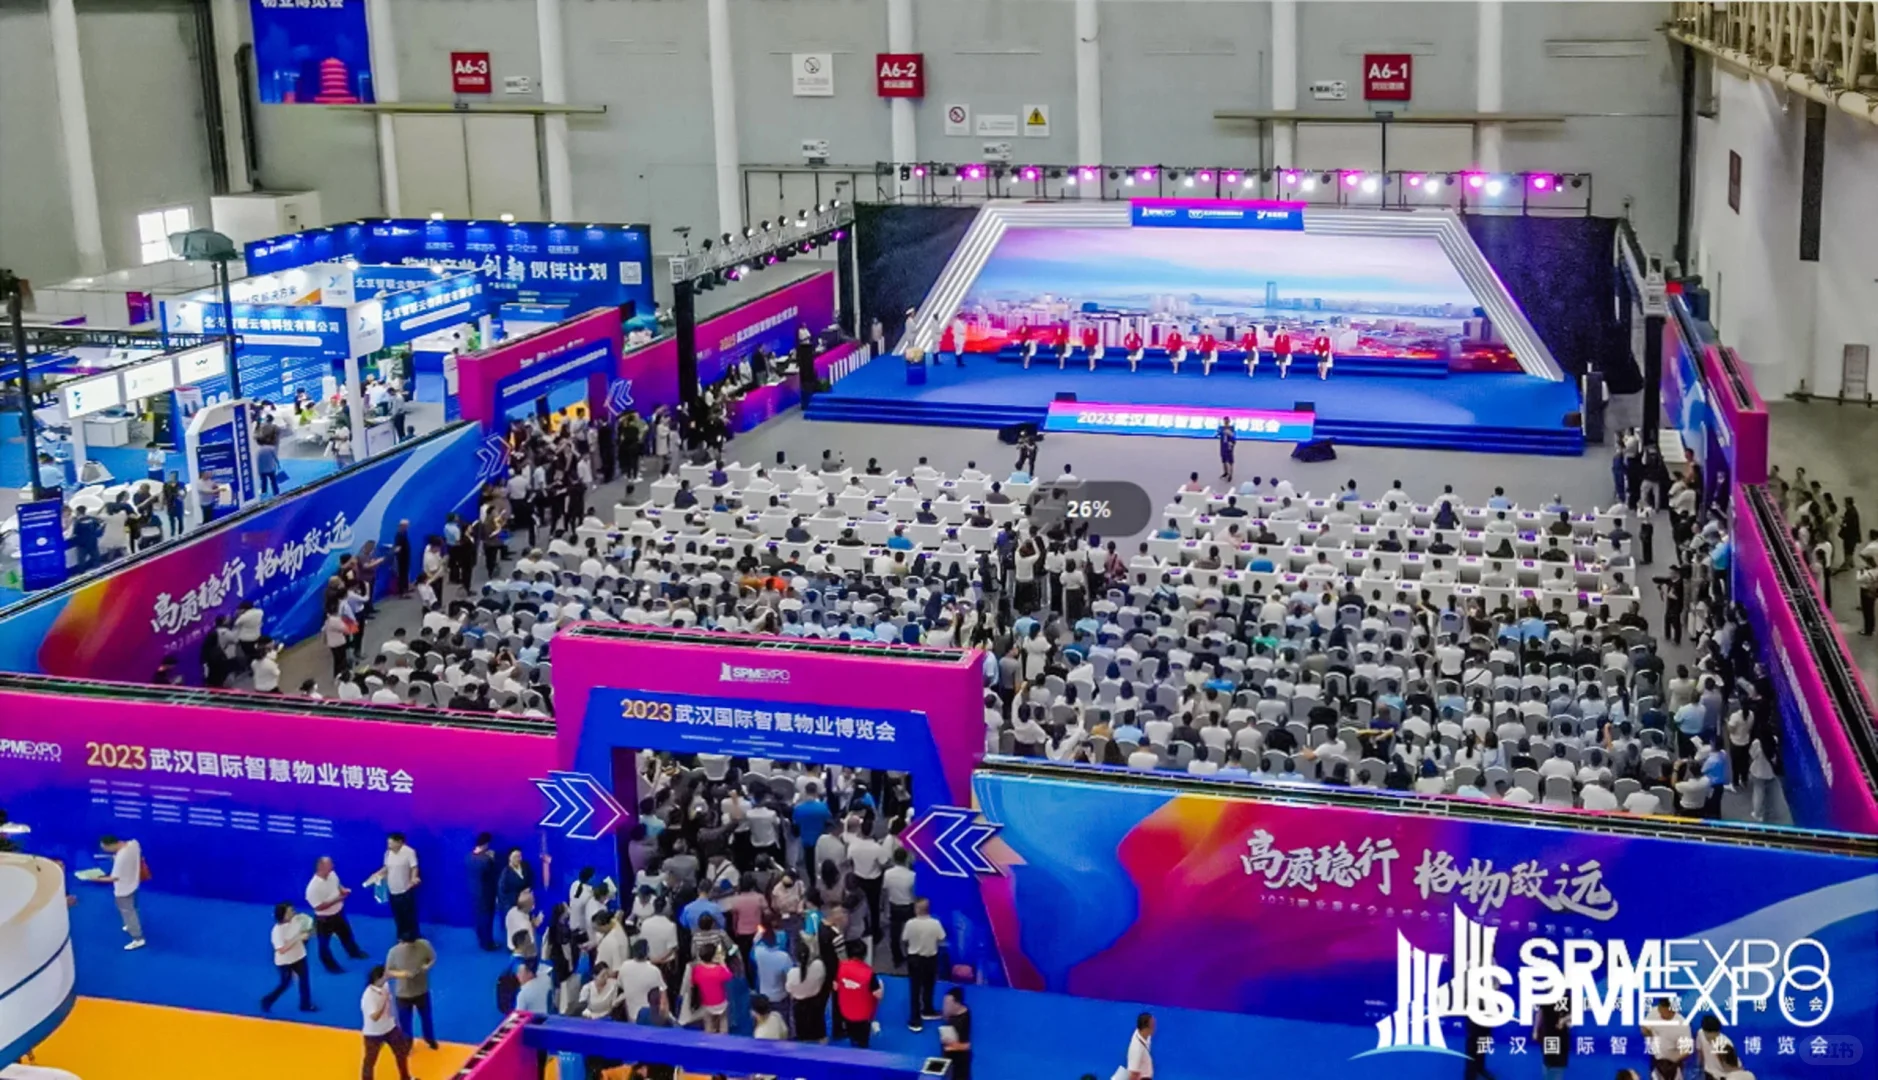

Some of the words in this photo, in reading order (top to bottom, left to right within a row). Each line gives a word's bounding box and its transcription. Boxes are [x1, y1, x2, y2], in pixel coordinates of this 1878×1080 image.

[455, 60, 488, 74] A6-3
[880, 61, 917, 78] A6-2
[1368, 62, 1408, 79] A6-1
[620, 699, 896, 742] 2023武汉国际智慧物业博览会
[0, 738, 62, 759] PMEXPO
[86, 741, 414, 794] 2023武汉国际智慧物业博览会
[1240, 828, 1400, 895] 高质稳行
[1413, 848, 1619, 922] 格物致远
